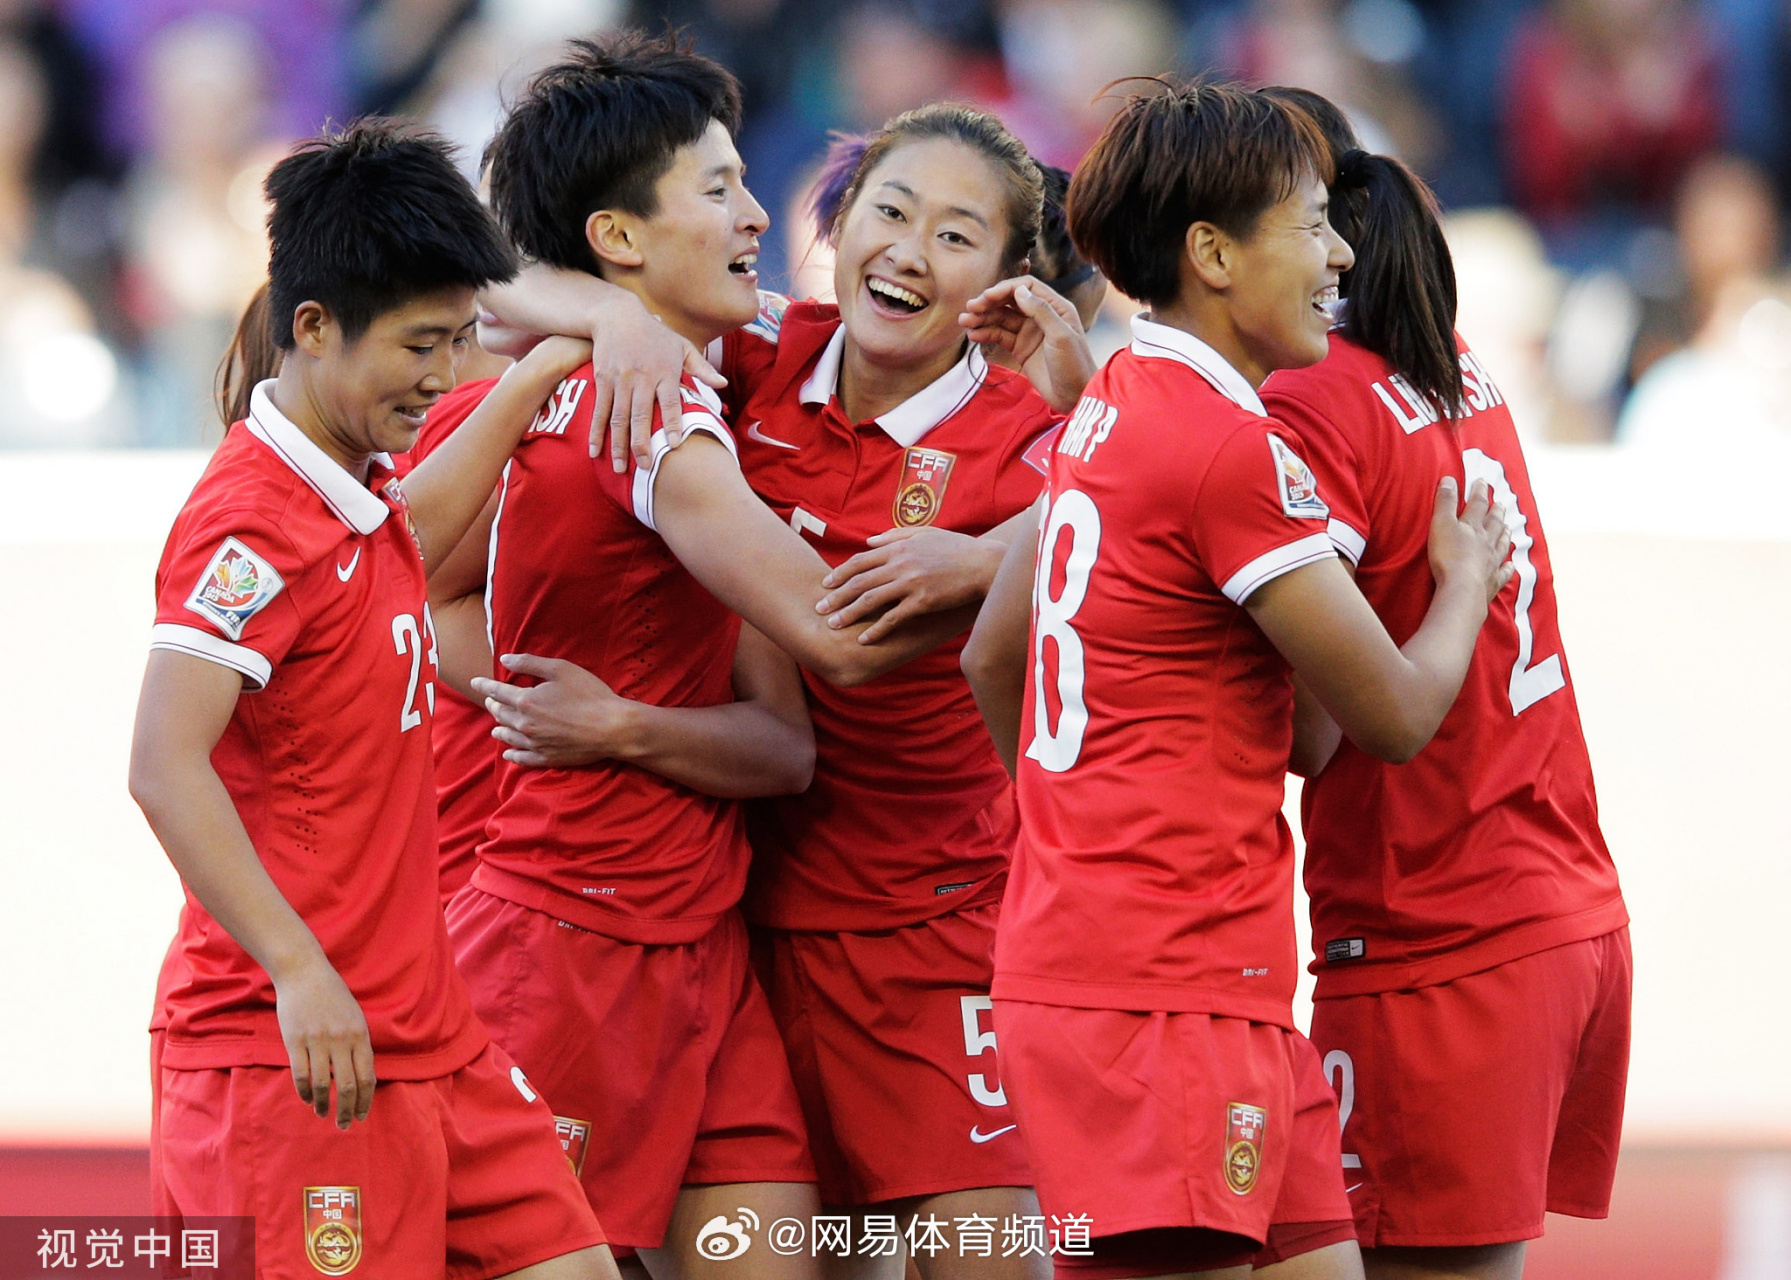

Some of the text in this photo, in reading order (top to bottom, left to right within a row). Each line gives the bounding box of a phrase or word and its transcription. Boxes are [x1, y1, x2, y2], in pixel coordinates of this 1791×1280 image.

[528, 379, 589, 434] SH
[908, 452, 950, 473] CFA
[1462, 448, 1567, 717] 2
[205, 586, 235, 603] CANADA
[582, 887, 617, 895] DRI-FIT
[1242, 968, 1269, 977] DRI-FIT
[960, 995, 1008, 1107] 5
[1231, 1108, 1264, 1130] CFA
[1323, 1049, 1363, 1169] 2
[555, 1122, 586, 1142] FA
[308, 1192, 356, 1208] CFA
[322, 1208, 343, 1220] 中国
